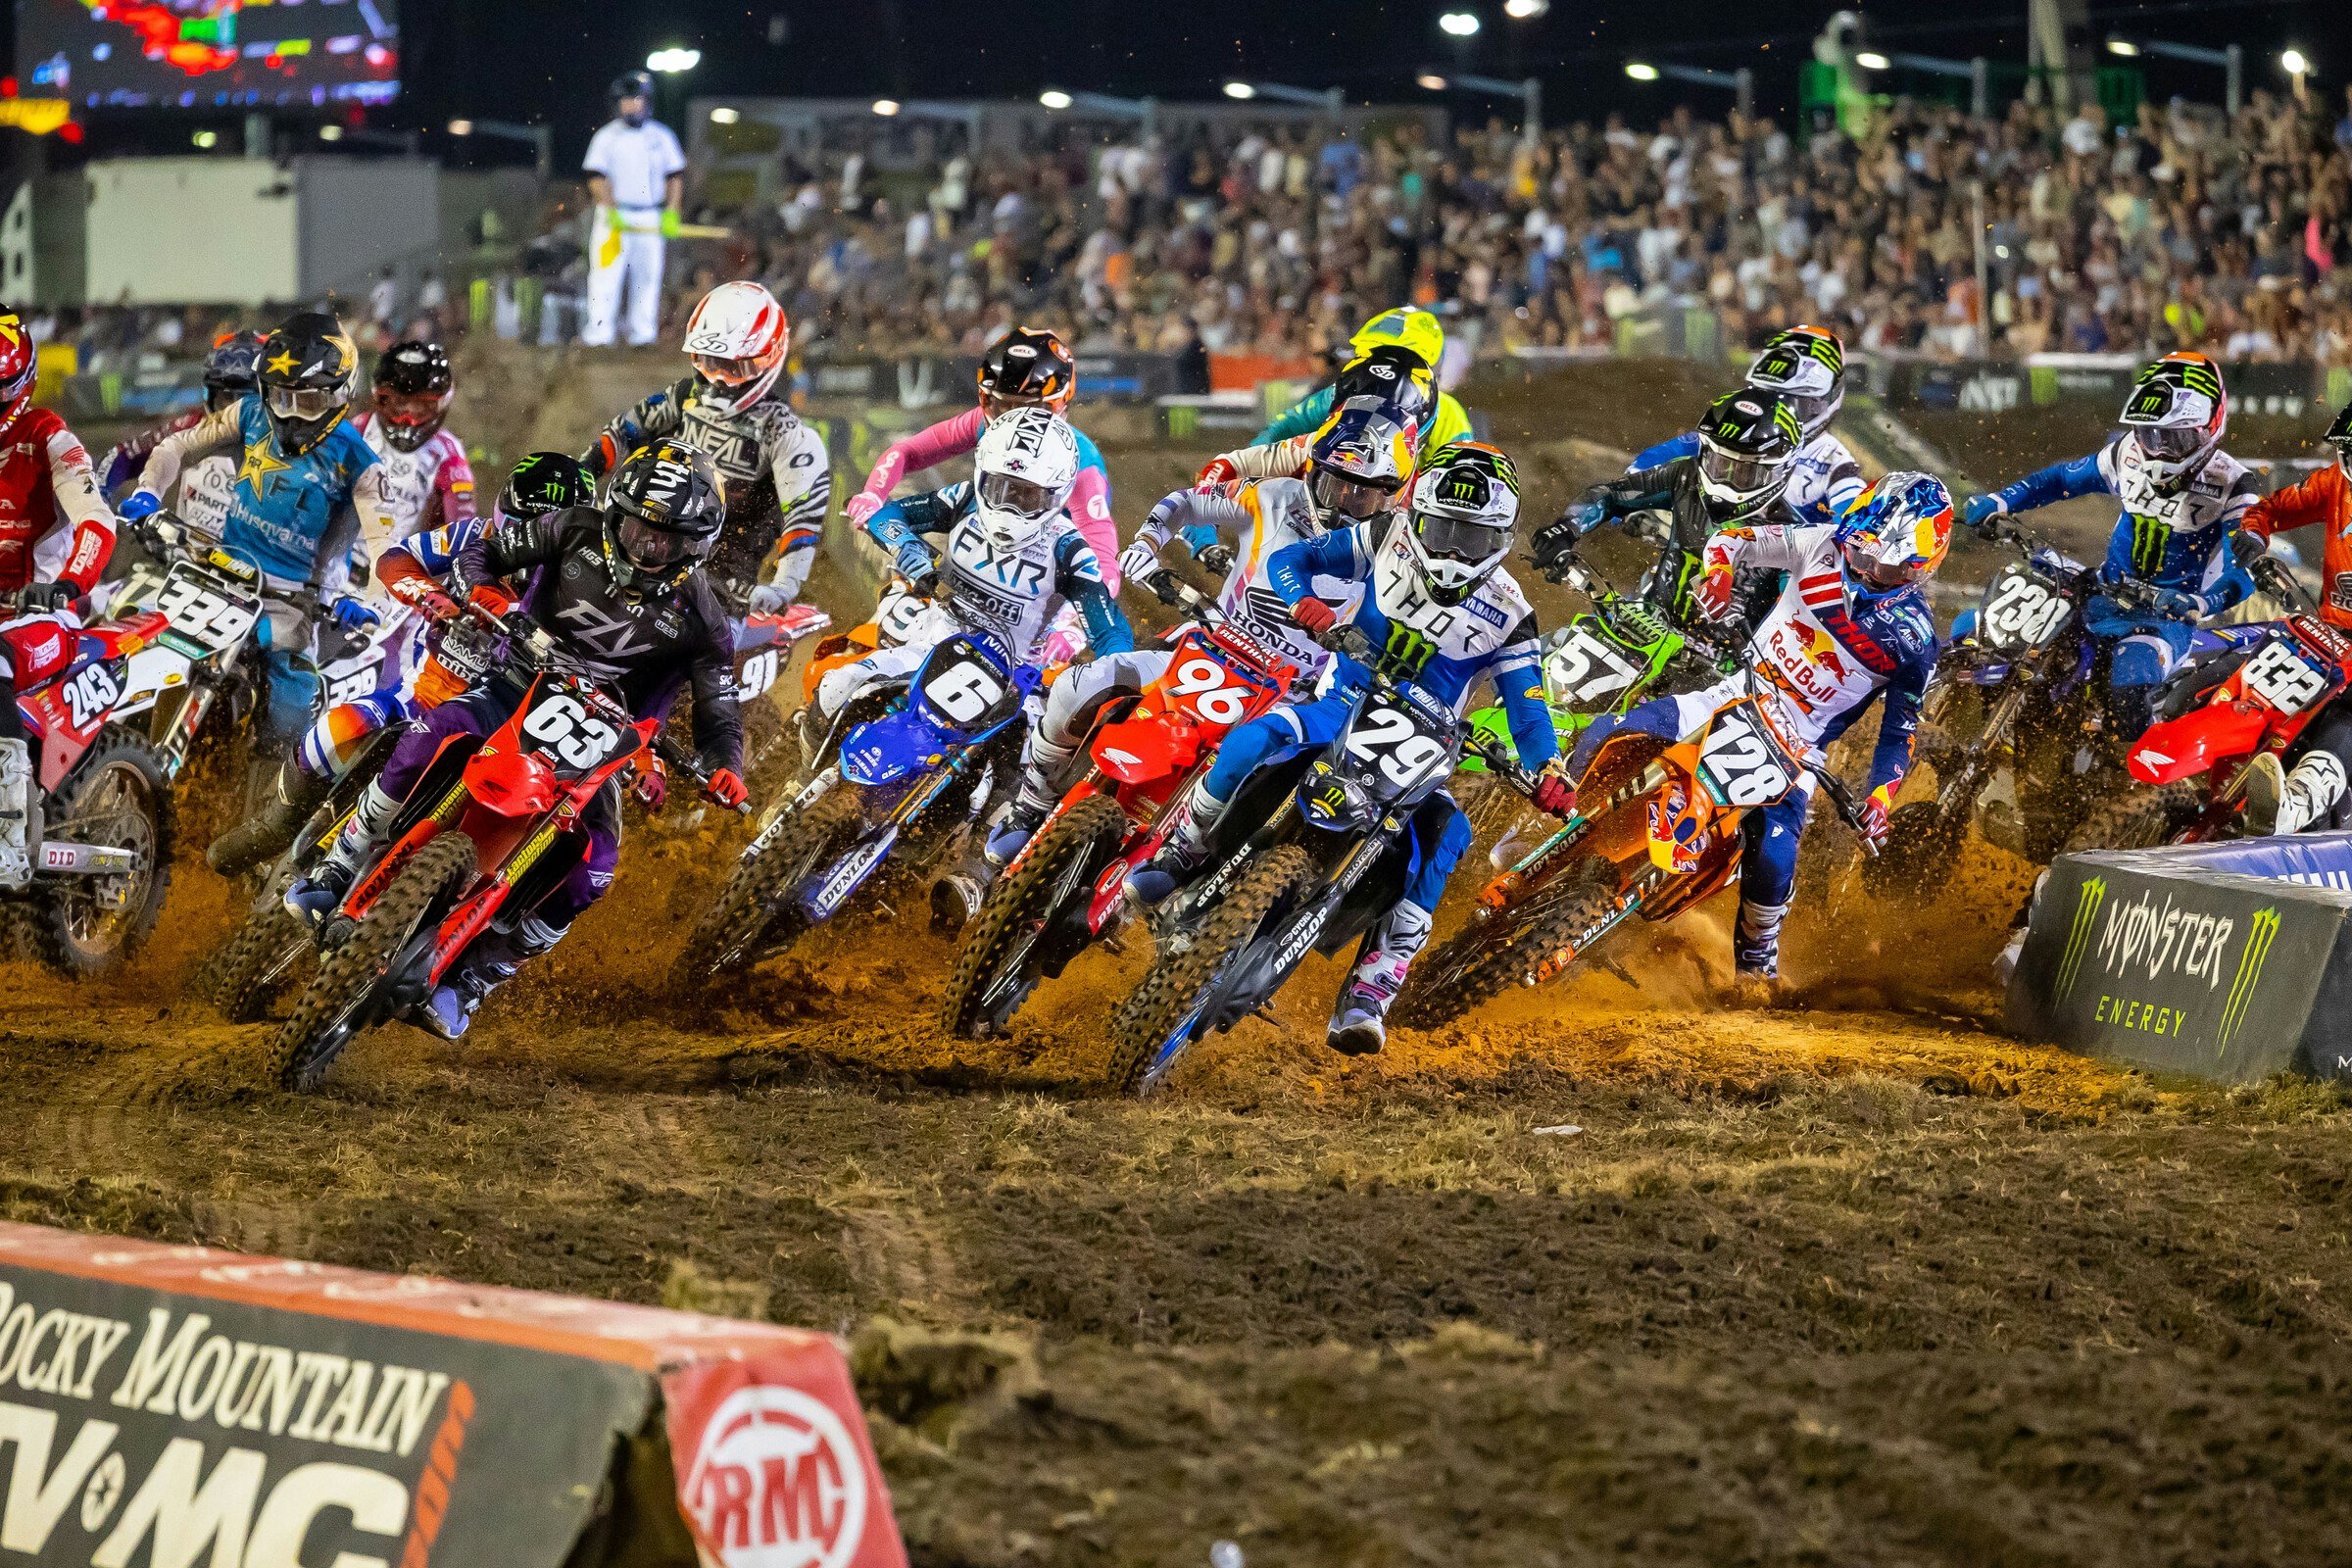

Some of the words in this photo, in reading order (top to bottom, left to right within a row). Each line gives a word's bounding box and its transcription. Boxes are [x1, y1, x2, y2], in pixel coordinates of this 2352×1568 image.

[1739, 403, 1758, 415] BELL
[237, 505, 316, 551] Husqvarna
[1439, 497, 1481, 511] MONSTER
[577, 546, 604, 567] HGS
[953, 527, 1048, 597] FXR
[158, 579, 255, 650] 339
[555, 597, 657, 660] FLY
[1232, 609, 1315, 667] HONDA
[1465, 597, 1504, 626] YAMAHA
[1827, 608, 1898, 674] THOR
[2299, 619, 2347, 659] RENTHAL
[1218, 628, 1273, 668] RENTHAL
[1550, 631, 1642, 704] 57
[1769, 628, 1797, 674] Red
[1794, 665, 1838, 704] Bull
[2241, 641, 2328, 716] 832
[63, 662, 120, 729] 243
[925, 661, 1004, 722] 6
[1170, 658, 1257, 726] 96
[1180, 704, 1206, 724] HONDA
[522, 695, 619, 770] 63
[1345, 708, 1447, 789] 29
[1701, 711, 1788, 807] 128
[1100, 752, 1130, 777] HONDA
[49, 850, 74, 866] DID
[822, 843, 879, 906] DUNLOP
[1196, 842, 1252, 908] DUNLOP
[1274, 906, 1328, 975] DUNLOP
[1292, 910, 1314, 936] CYCRA
[1582, 892, 1637, 945] DUNLP
[2096, 889, 2234, 993] MONSTER
[2094, 996, 2187, 1038] ENERGY
[129, 1305, 454, 1457] MOUNTAIN
